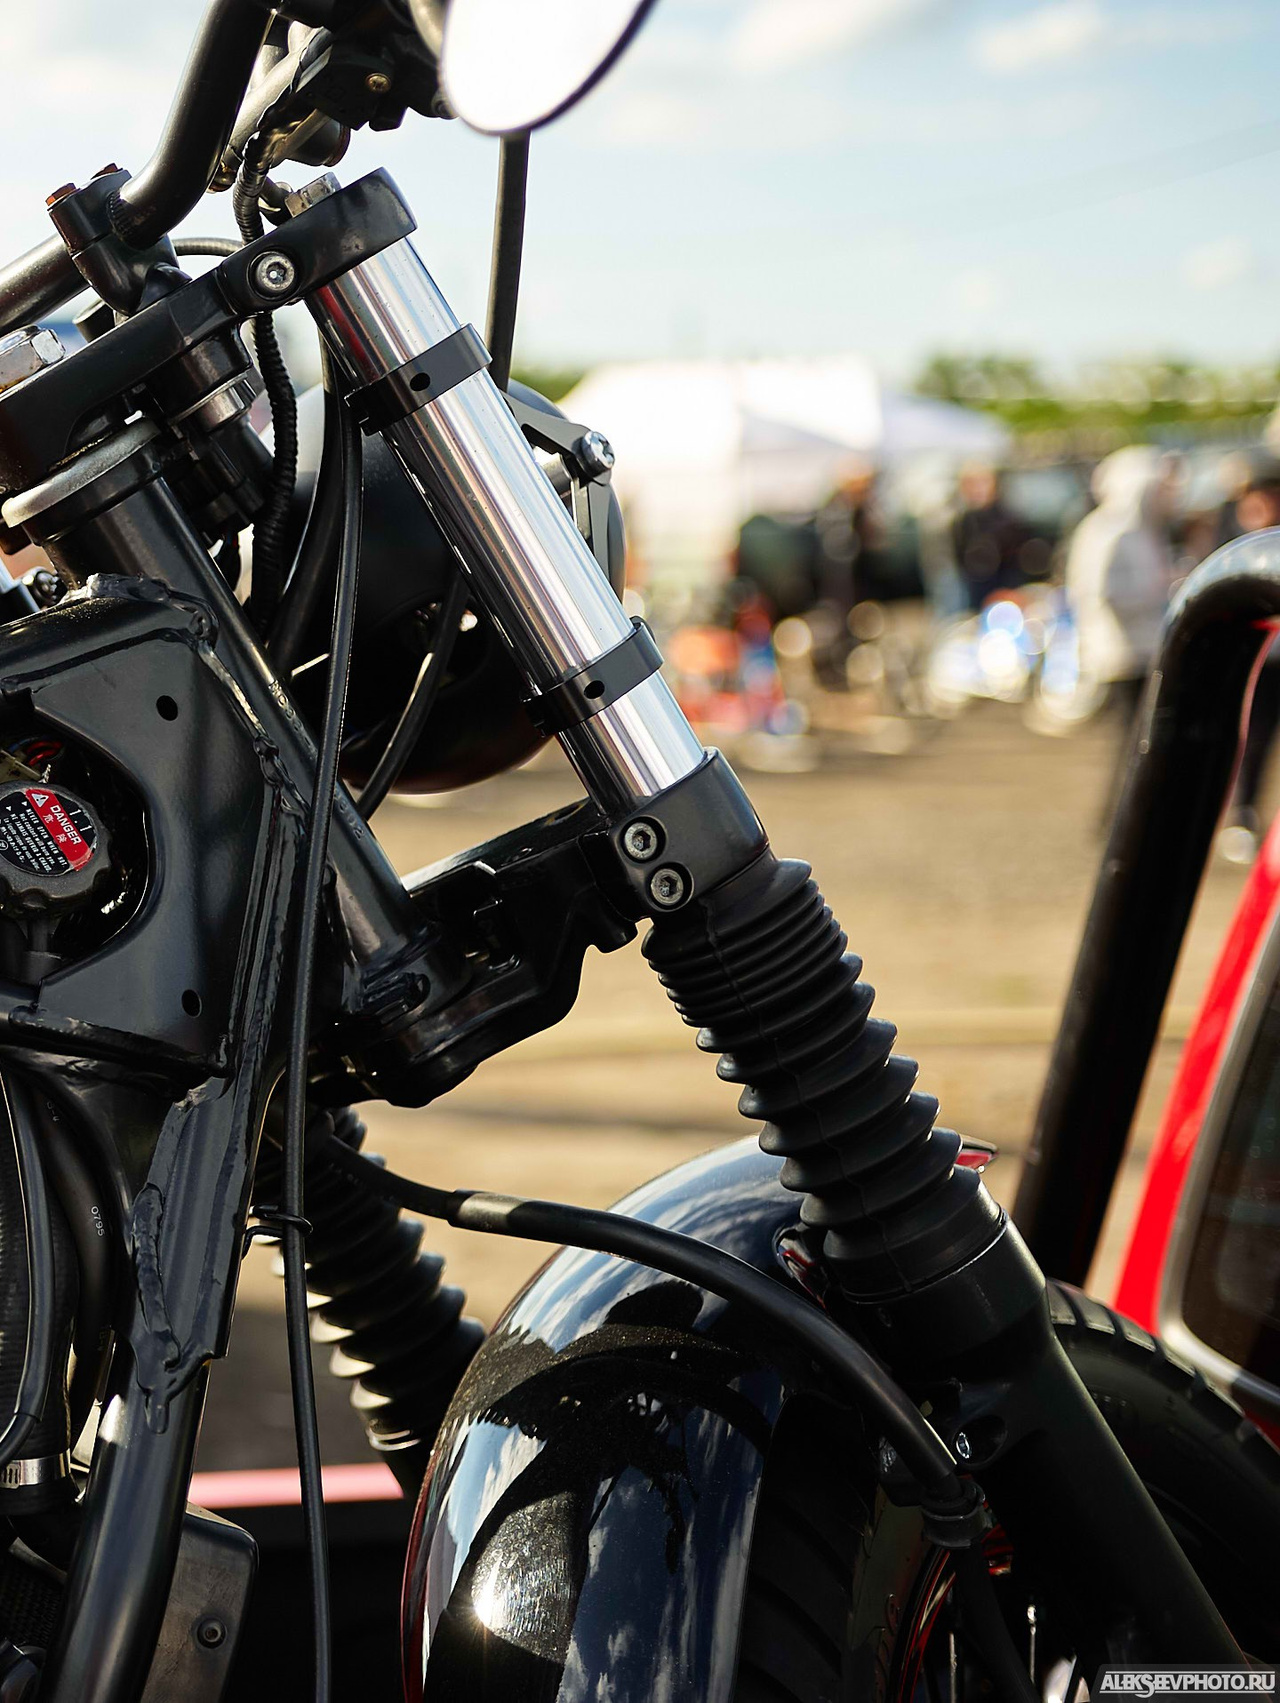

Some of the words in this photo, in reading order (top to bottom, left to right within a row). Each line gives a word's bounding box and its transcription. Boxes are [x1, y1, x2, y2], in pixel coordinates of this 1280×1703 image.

[26, 808, 39, 823] NEVER
[37, 826, 48, 838] OPEN
[50, 805, 81, 844] DANGER
